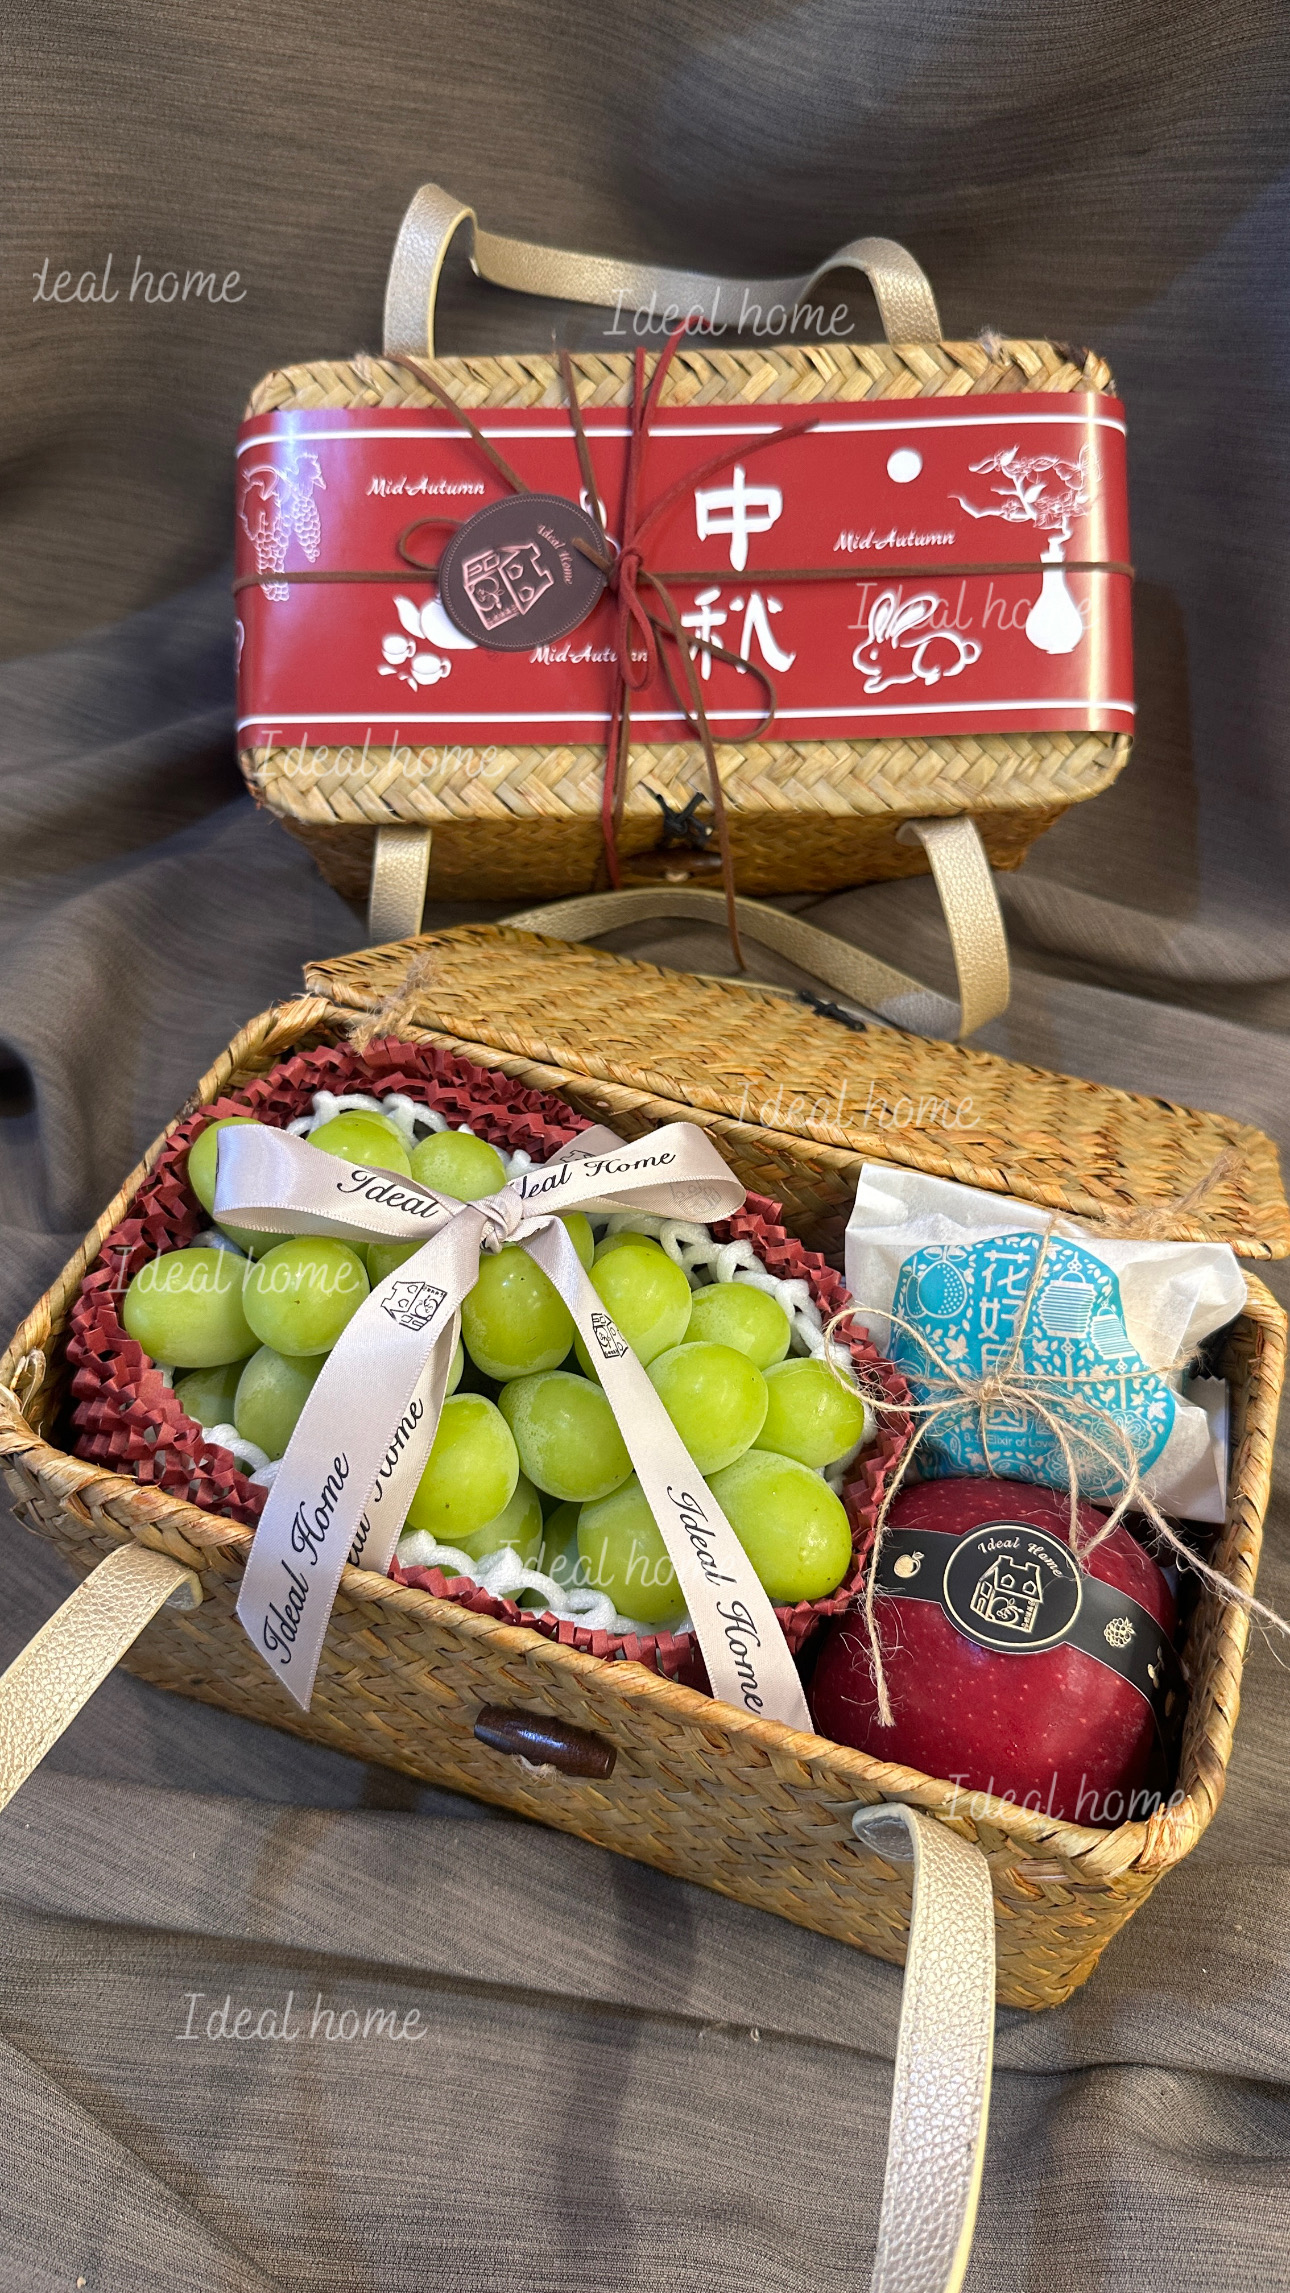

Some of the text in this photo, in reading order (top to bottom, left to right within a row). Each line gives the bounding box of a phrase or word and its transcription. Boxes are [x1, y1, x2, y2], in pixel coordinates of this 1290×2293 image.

[366, 474, 486, 498] Mid-Autumn
[537, 522, 566, 551] Ideal
[832, 526, 956, 553] Mid-Autumn
[681, 464, 796, 681] 中秋
[584, 1152, 677, 1177] Home
[336, 1169, 441, 1219] Ideal
[987, 1433, 1012, 1446] Elixir
[1015, 1437, 1027, 1447] of
[263, 1452, 350, 1664] Ideal Home
[977, 1536, 1063, 1577] Ideal Home
[666, 1485, 764, 1715] Ideal Home
